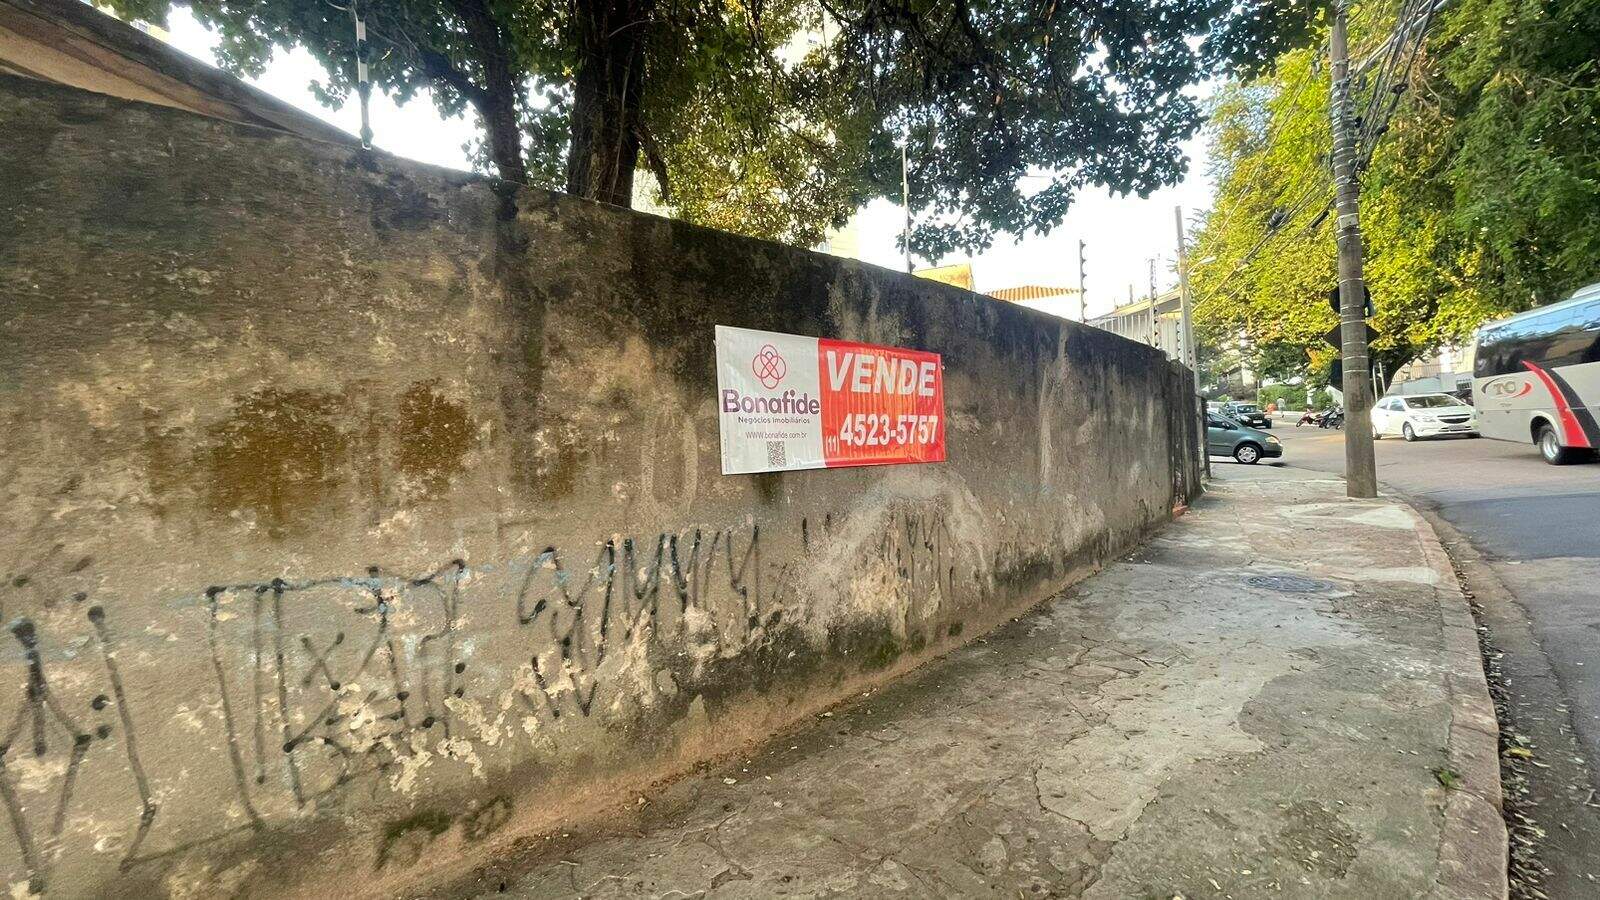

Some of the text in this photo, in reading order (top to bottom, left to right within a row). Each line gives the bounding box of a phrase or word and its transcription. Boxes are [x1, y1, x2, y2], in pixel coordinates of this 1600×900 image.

[826, 350, 937, 396] VENDE
[722, 388, 820, 415] Bonafide
[738, 415, 810, 425] Negócios Imobiliários
[825, 413, 938, 455] (11) 4523-5757
